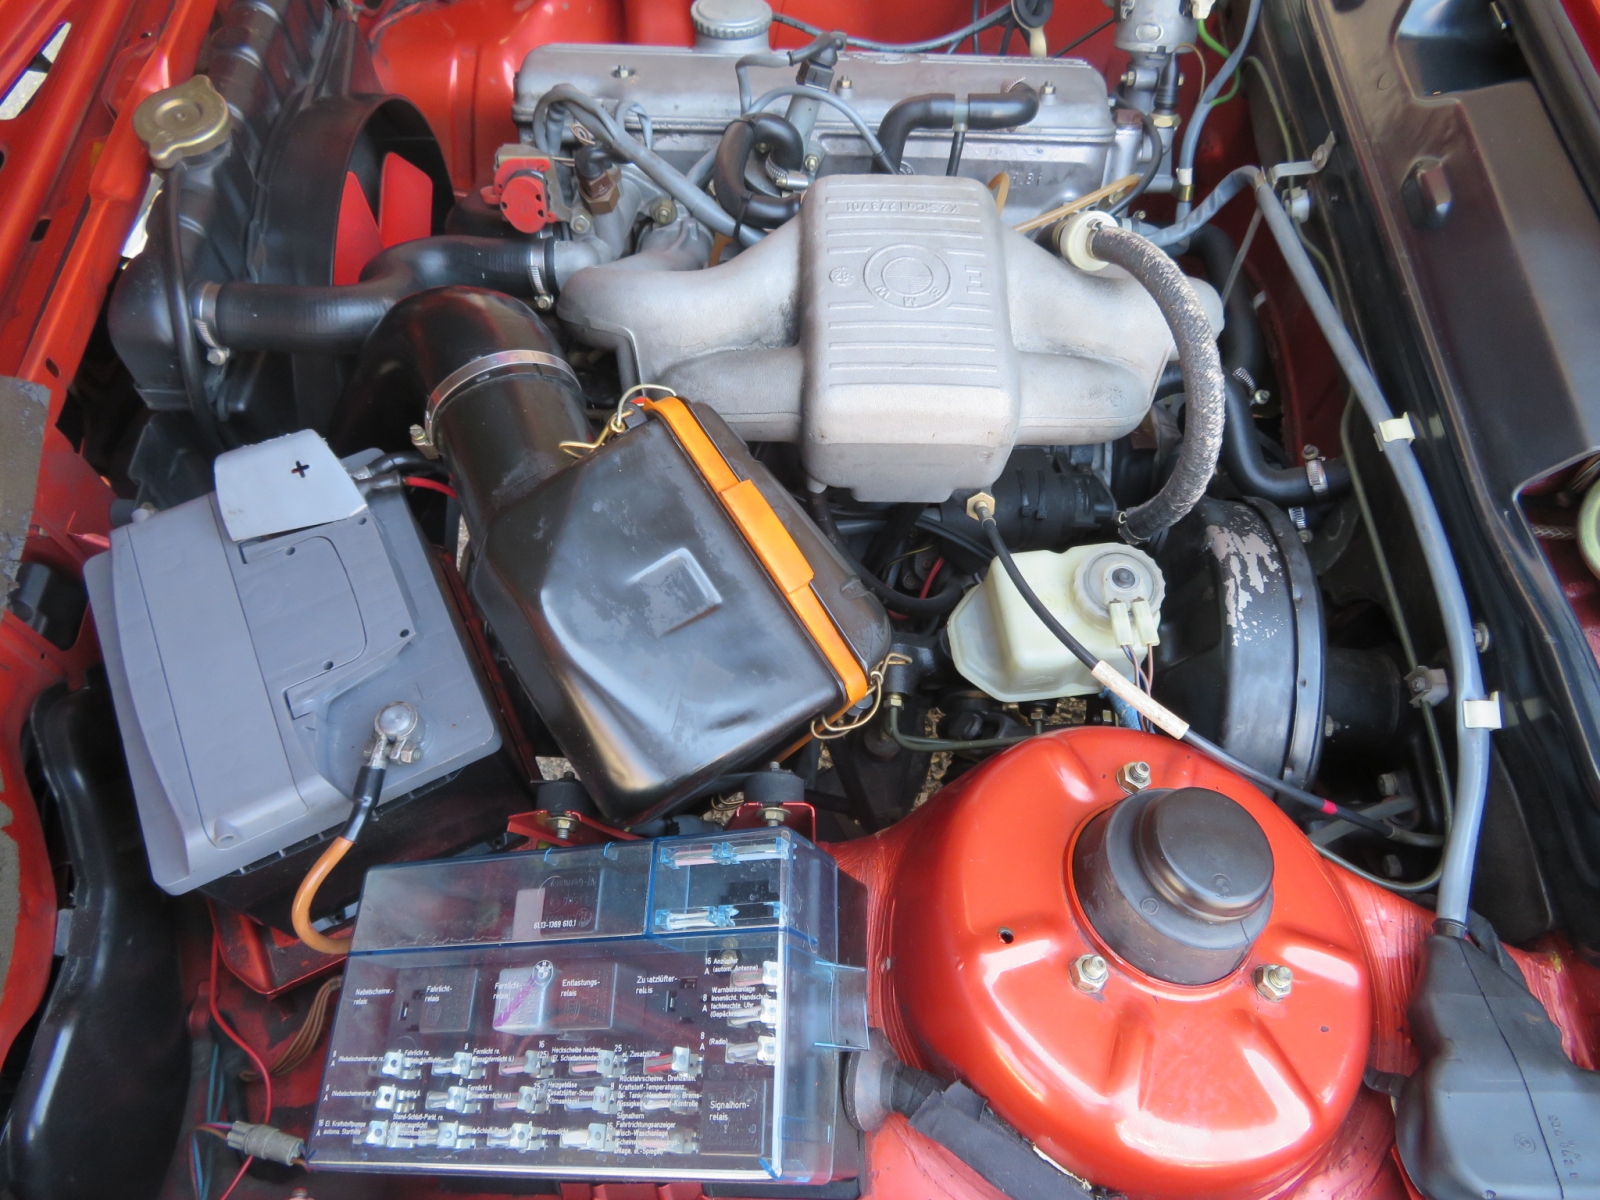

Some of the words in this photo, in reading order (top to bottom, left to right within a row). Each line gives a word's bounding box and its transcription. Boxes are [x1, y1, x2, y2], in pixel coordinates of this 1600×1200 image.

[705, 957, 711, 965] 16
[734, 964, 759, 972] Antenne)
[494, 982, 522, 991] Fernlicht-
[562, 979, 601, 988] Entlastungs-
[426, 985, 453, 993] Fahrlicht-
[560, 989, 577, 997] relais
[711, 986, 756, 995] Warnblinkanlage
[424, 995, 440, 1003] relais
[493, 992, 509, 1000] relais
[702, 994, 708, 1002] 8
[739, 993, 772, 1002] Handschuh-
[353, 998, 368, 1006] relais
[702, 1004, 708, 1012] A
[700, 1031, 705, 1040] 8
[539, 1041, 545, 1049] 16
[709, 1038, 728, 1046] (Radio)
[551, 1046, 582, 1054] Heckscheibe
[613, 1044, 622, 1052] 25
[629, 1050, 661, 1059] Zusatzlüfter
[467, 1083, 488, 1091] Fernlicht
[548, 1081, 578, 1091] Heizgebläse
[610, 1083, 615, 1091] 8
[681, 1091, 703, 1099] Brems-
[709, 1100, 751, 1111] Signalhorn-
[616, 1111, 645, 1121] Signalhorn
[709, 1112, 729, 1122] relais
[615, 1121, 677, 1130] Fahrtrichtungsanzeiger
